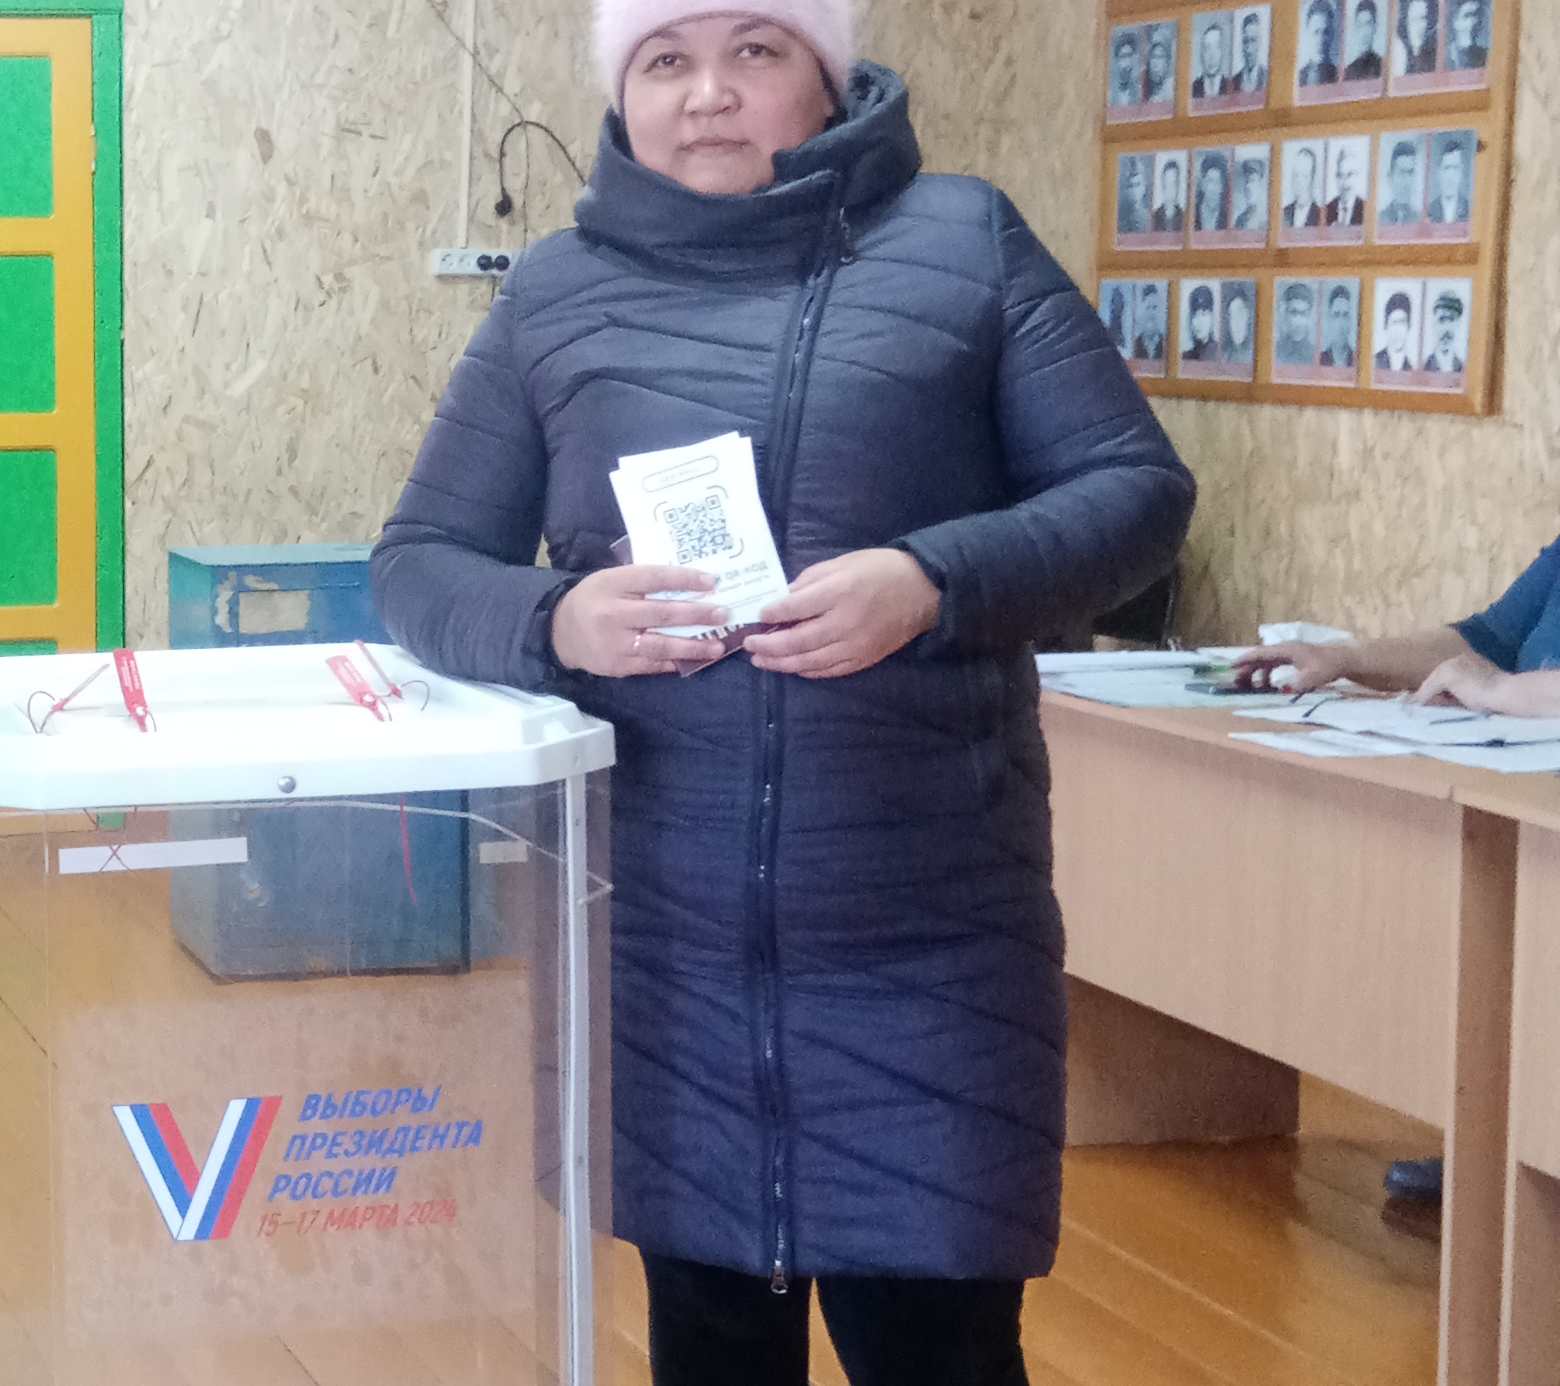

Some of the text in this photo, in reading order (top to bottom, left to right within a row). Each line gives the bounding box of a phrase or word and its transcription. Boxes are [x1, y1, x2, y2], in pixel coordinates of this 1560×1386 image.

[298, 1085, 441, 1122] ВЫБОРЫ
[283, 1120, 484, 1162] ПРЕЗИДЕНТА
[267, 1166, 398, 1202] РОССИИ
[322, 1203, 400, 1232] МАРТА
[403, 1199, 457, 1226] 2024
